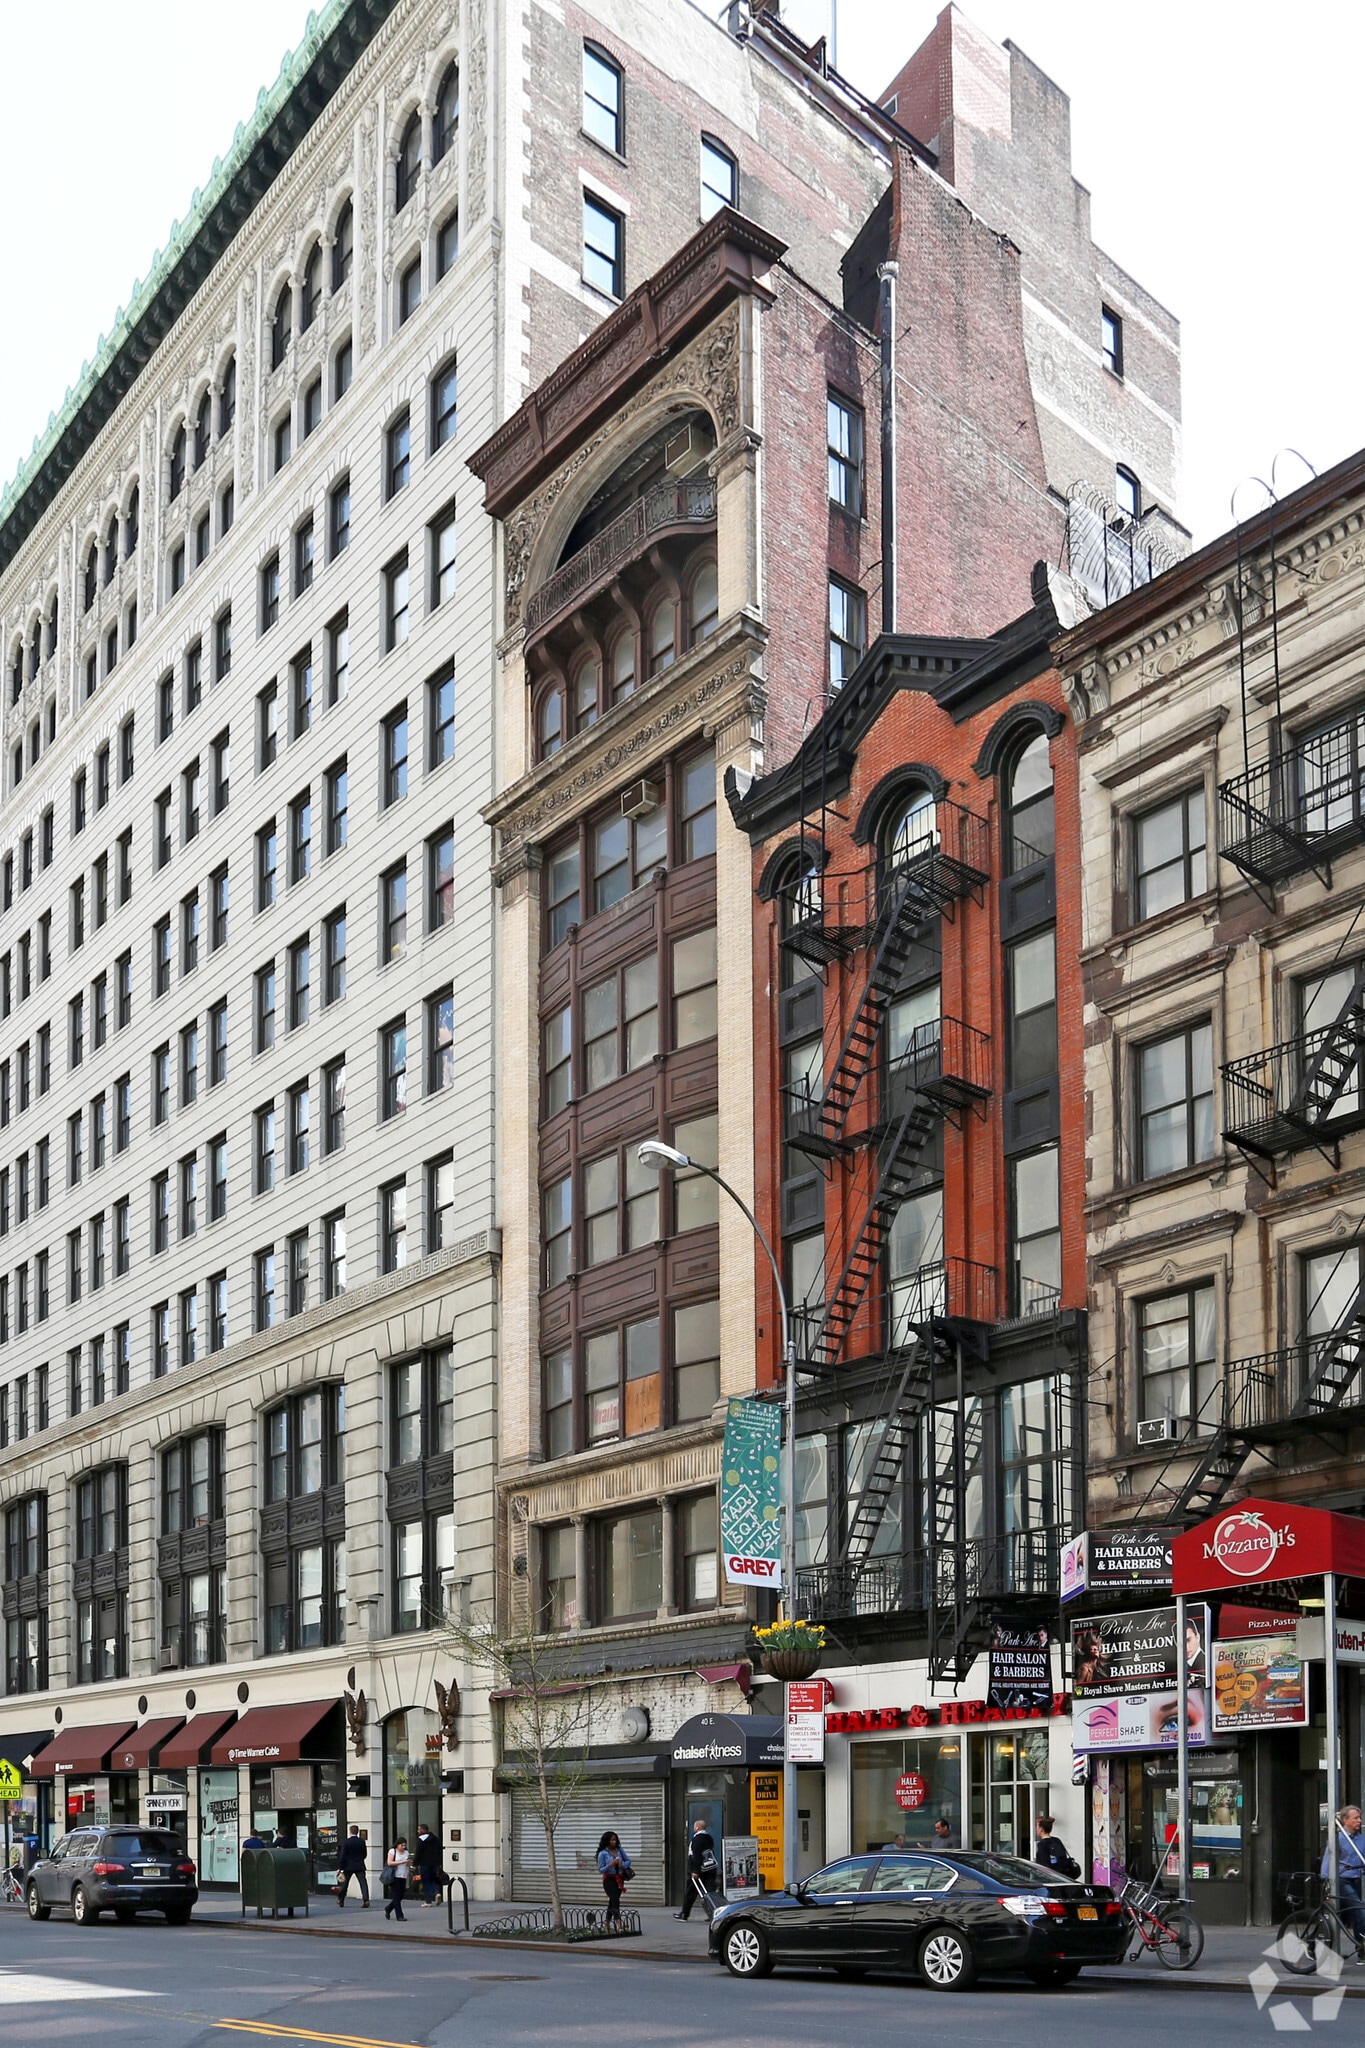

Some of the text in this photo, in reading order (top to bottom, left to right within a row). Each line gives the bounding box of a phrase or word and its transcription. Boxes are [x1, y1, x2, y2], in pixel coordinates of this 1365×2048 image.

[721, 1497, 747, 1528] MAD
[745, 1518, 780, 1557] MUSIC
[1112, 1533, 1135, 1544] Park
[1203, 1525, 1296, 1559] Mozzarelli's
[1095, 1546, 1164, 1558] HAIR SALON
[729, 1556, 776, 1576] GREY
[1098, 1559, 1161, 1570] & BARBERS
[1100, 1614, 1166, 1636] Park Ave
[1248, 1620, 1271, 1628] Pizza,
[1000, 1631, 1020, 1646] Park
[1102, 1636, 1174, 1654] HAIR SALON
[992, 1653, 1047, 1664] HAIR SALON
[1134, 1653, 1141, 1662] &
[1218, 1651, 1248, 1661] Better
[1234, 1656, 1264, 1668] Crumbs
[994, 1666, 1045, 1678] & BARBERS
[1110, 1662, 1166, 1677] BARBERS
[1084, 1686, 1102, 1696] Royal
[1103, 1684, 1123, 1693] Shave
[1125, 1681, 1153, 1692] Masters
[1154, 1680, 1164, 1688] Are
[790, 1715, 796, 1724] 3
[825, 1708, 900, 1733] HALE
[907, 1705, 931, 1727] &
[1090, 1726, 1144, 1738] PERFECT SHAPE
[1161, 1732, 1202, 1742] 212-4-7400
[235, 1746, 280, 1758] Time Warner Cable
[408, 1764, 424, 1777] 304
[756, 1778, 776, 1786] LEARN
[901, 1777, 918, 1786] HALE
[319, 1793, 332, 1803] 46A
[901, 1796, 918, 1806] SOUPS
[30, 1840, 36, 1848] P
